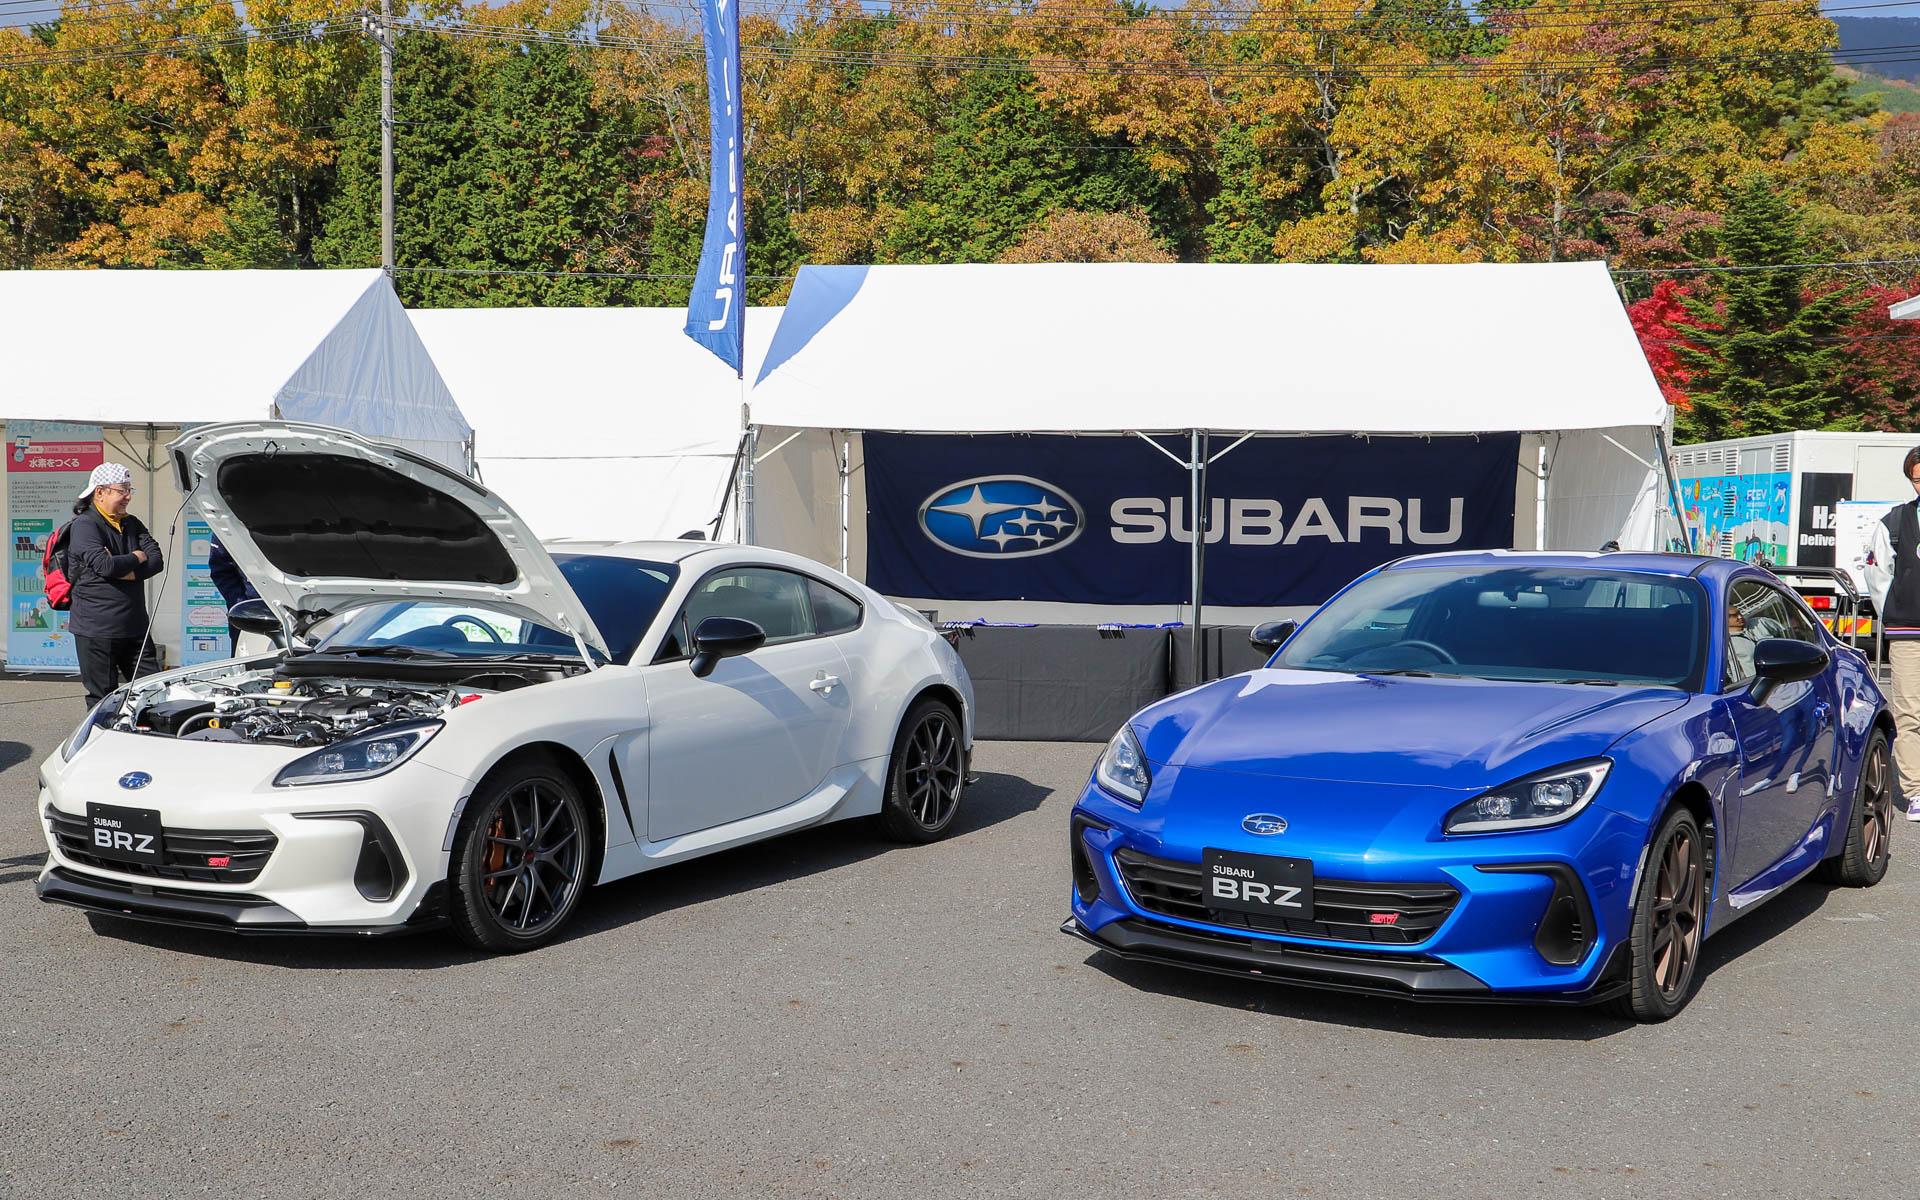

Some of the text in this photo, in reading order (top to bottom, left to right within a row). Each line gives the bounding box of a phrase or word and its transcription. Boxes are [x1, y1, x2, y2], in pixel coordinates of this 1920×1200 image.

[29, 458, 80, 468] 水素をつくる
[1747, 489, 1767, 501] FCEV
[1110, 495, 1464, 545] SUBARU
[93, 817, 122, 829] SUBARU
[94, 828, 155, 854] BRZ
[1212, 864, 1255, 879] SUBARU
[1212, 876, 1302, 908] BRZ
